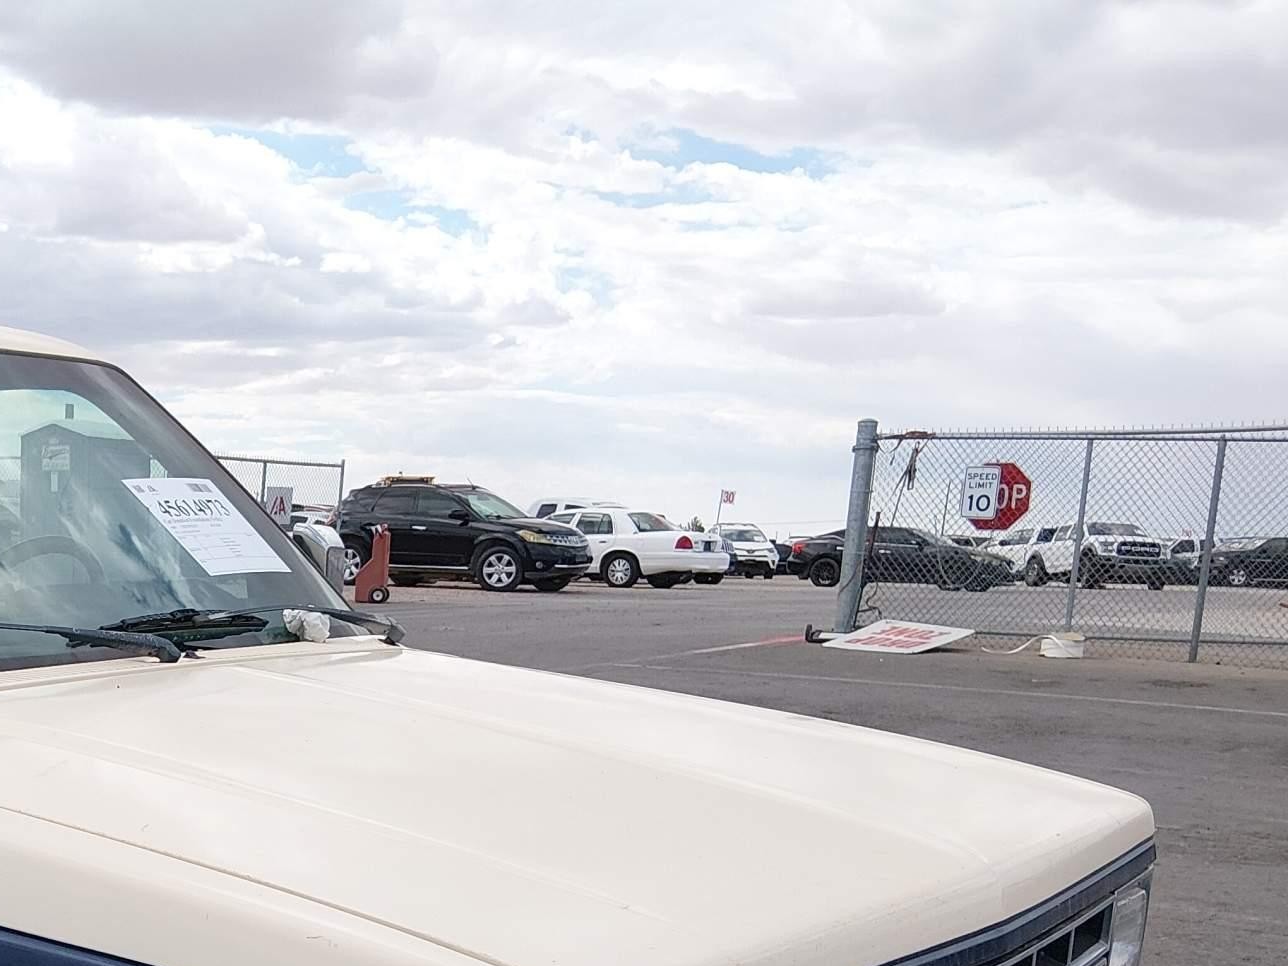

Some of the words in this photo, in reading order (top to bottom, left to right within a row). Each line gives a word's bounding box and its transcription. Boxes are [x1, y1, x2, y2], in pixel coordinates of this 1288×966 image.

[968, 472, 998, 481] SPEED
[968, 481, 994, 489] LIMIT
[968, 494, 991, 512] 10
[996, 483, 1027, 510] OP
[157, 499, 231, 517] 45614973
